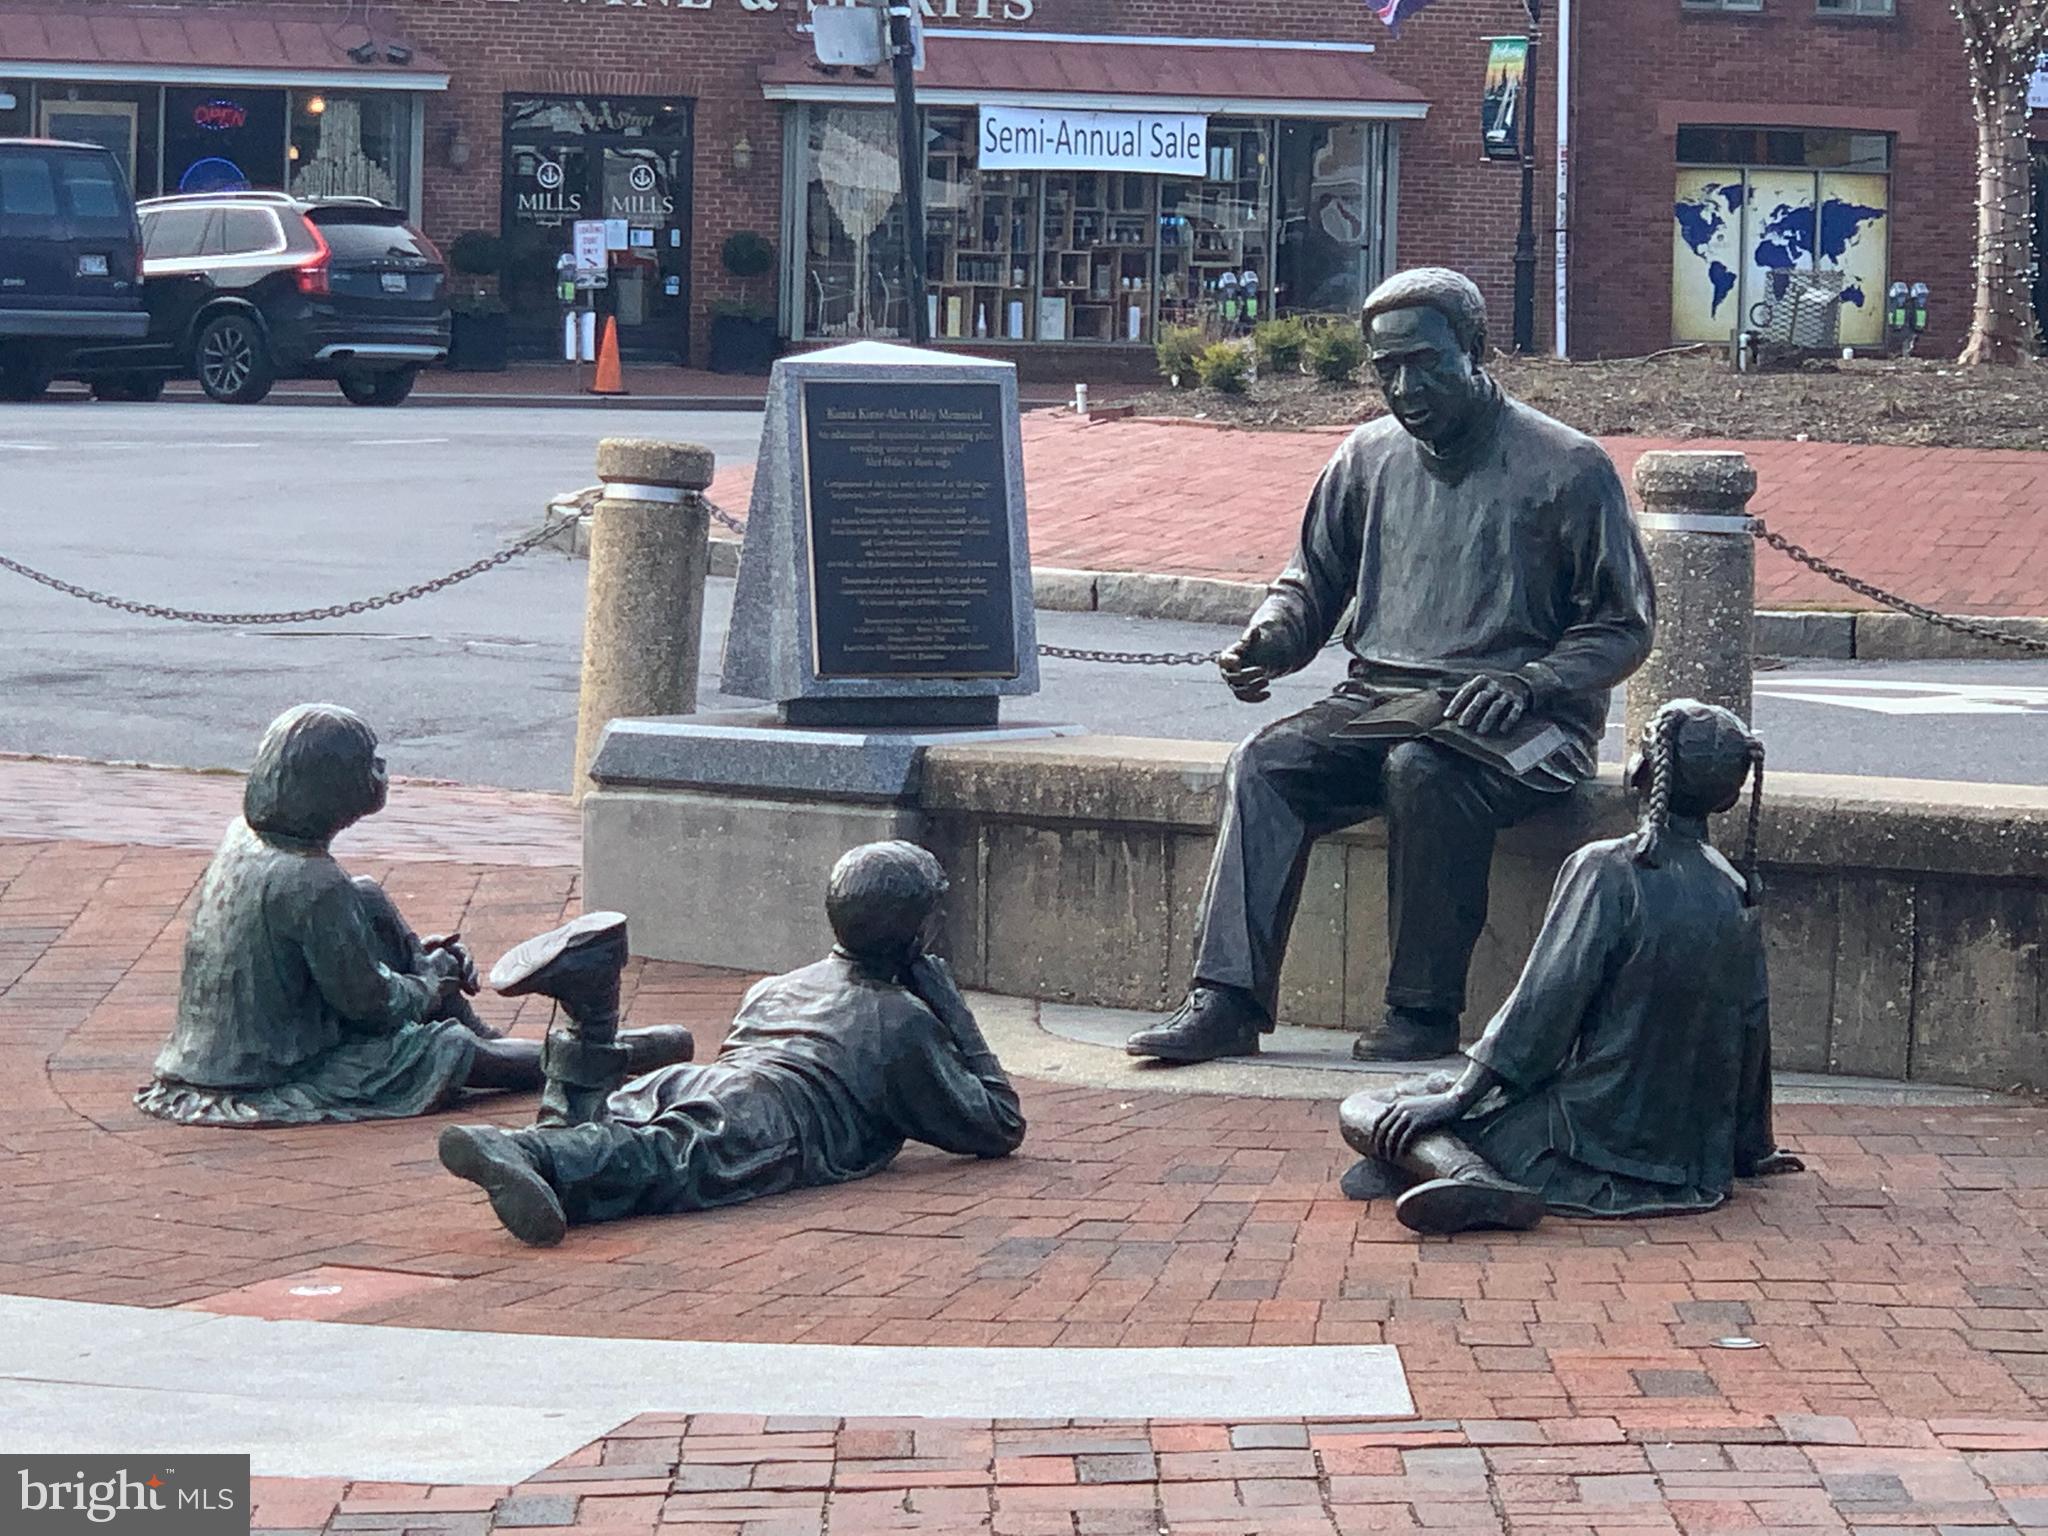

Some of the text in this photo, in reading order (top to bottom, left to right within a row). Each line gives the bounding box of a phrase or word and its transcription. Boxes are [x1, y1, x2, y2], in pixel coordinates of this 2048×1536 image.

[194, 105, 246, 127] OPEN
[985, 116, 1201, 159] Semi-Annual Sale
[518, 193, 582, 211] MILLS
[611, 196, 674, 214] MILLS
